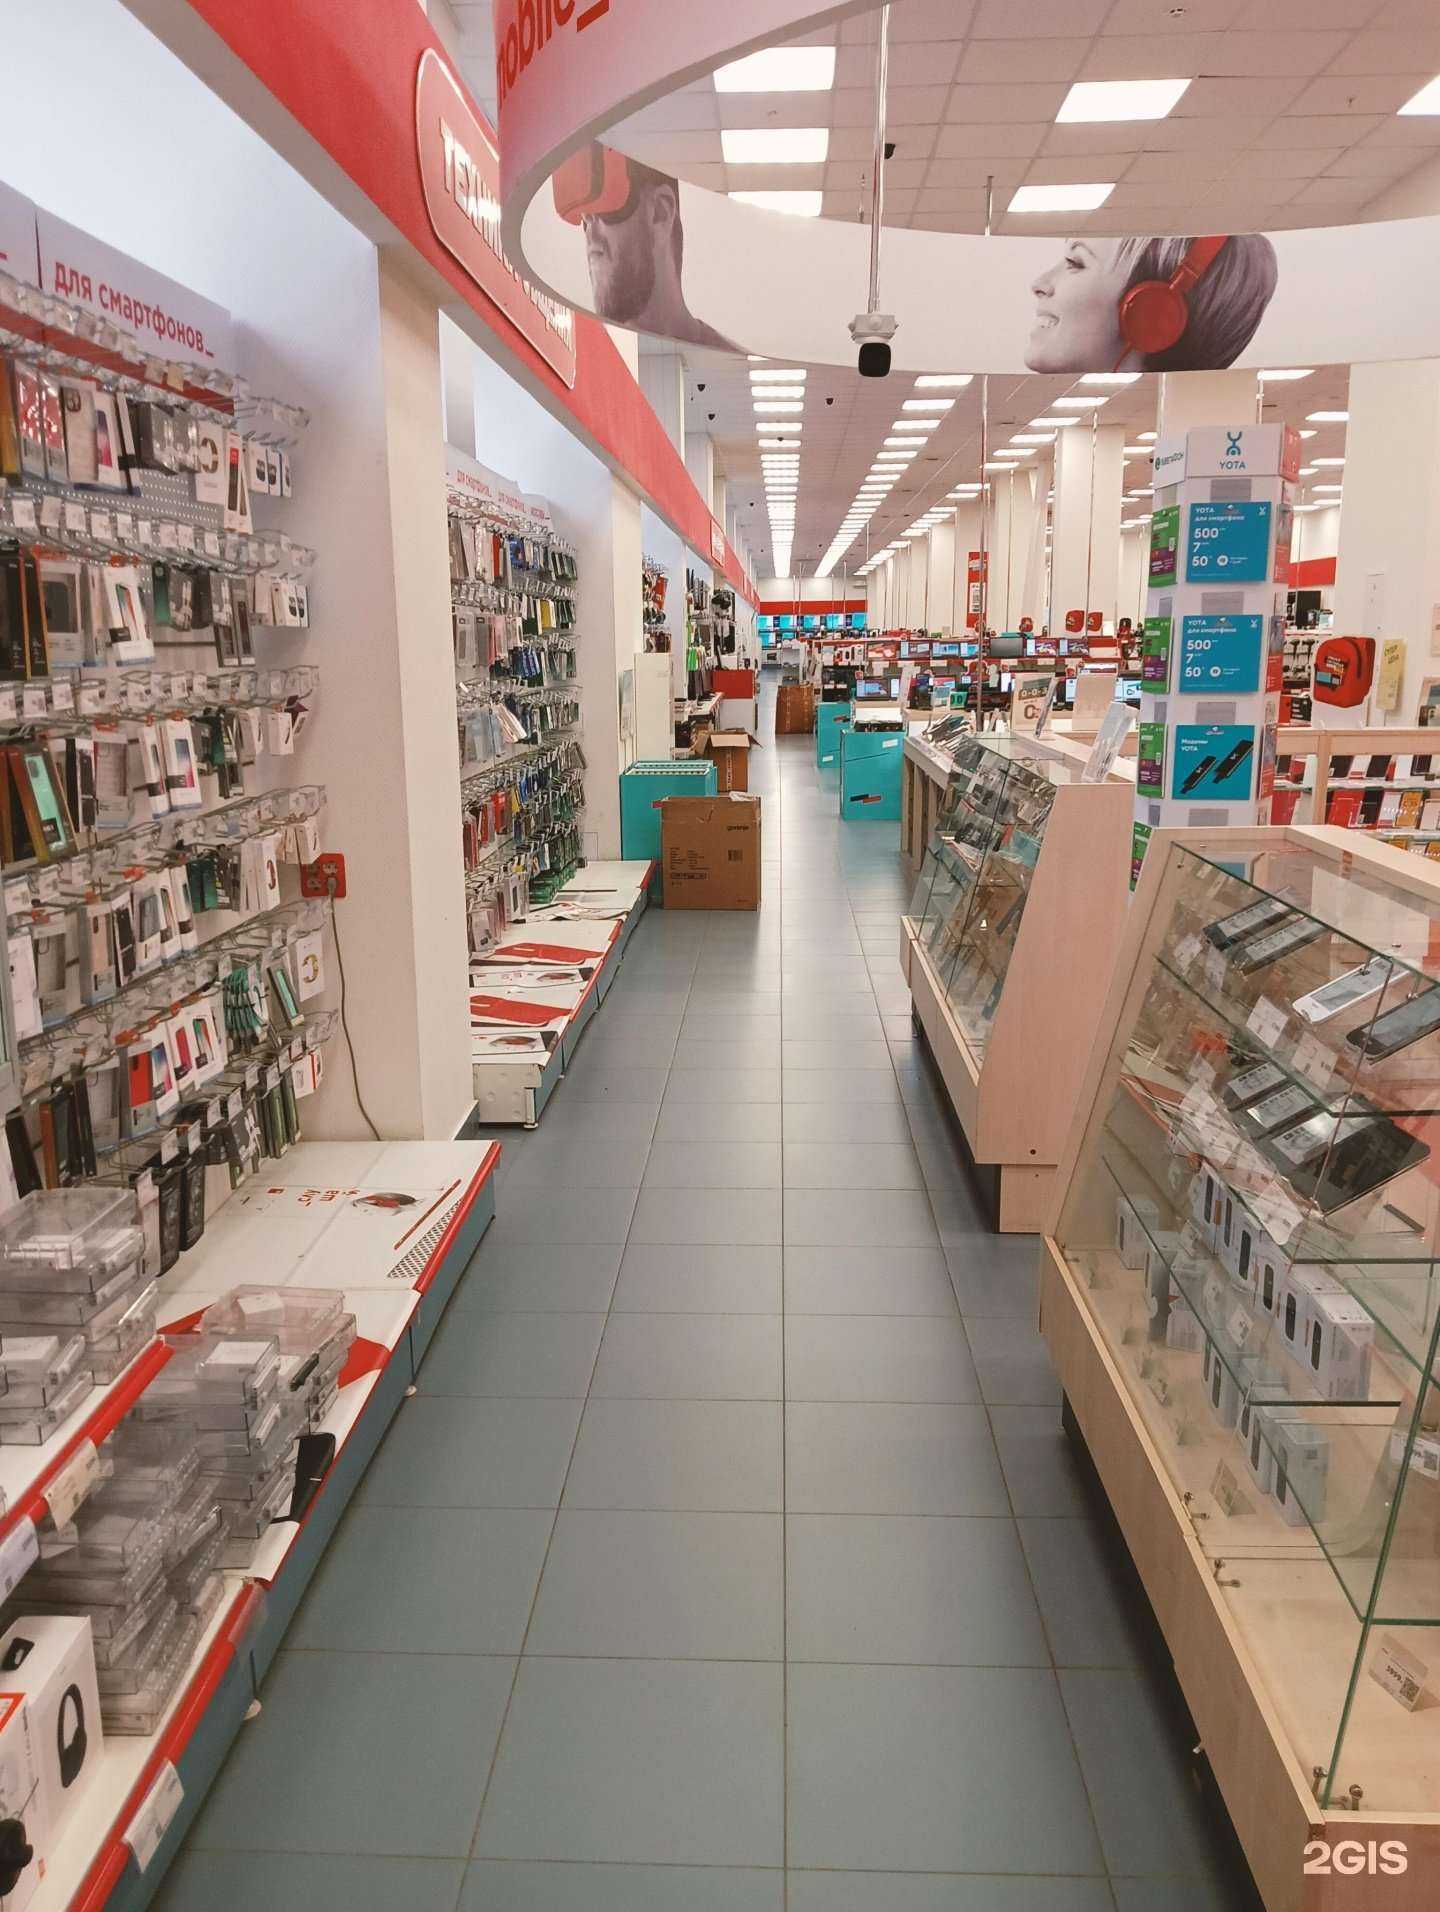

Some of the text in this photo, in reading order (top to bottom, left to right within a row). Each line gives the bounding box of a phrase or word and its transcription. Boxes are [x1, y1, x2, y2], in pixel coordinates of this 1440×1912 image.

[55, 262, 92, 301] для
[1219, 461, 1246, 470] YOTA
[1194, 527, 1219, 539] 500
[1192, 542, 1201, 553] 7
[1192, 555, 1208, 566] 50
[1187, 639, 1212, 650] 500
[1185, 653, 1194, 664] 7
[1185, 666, 1201, 677] 50
